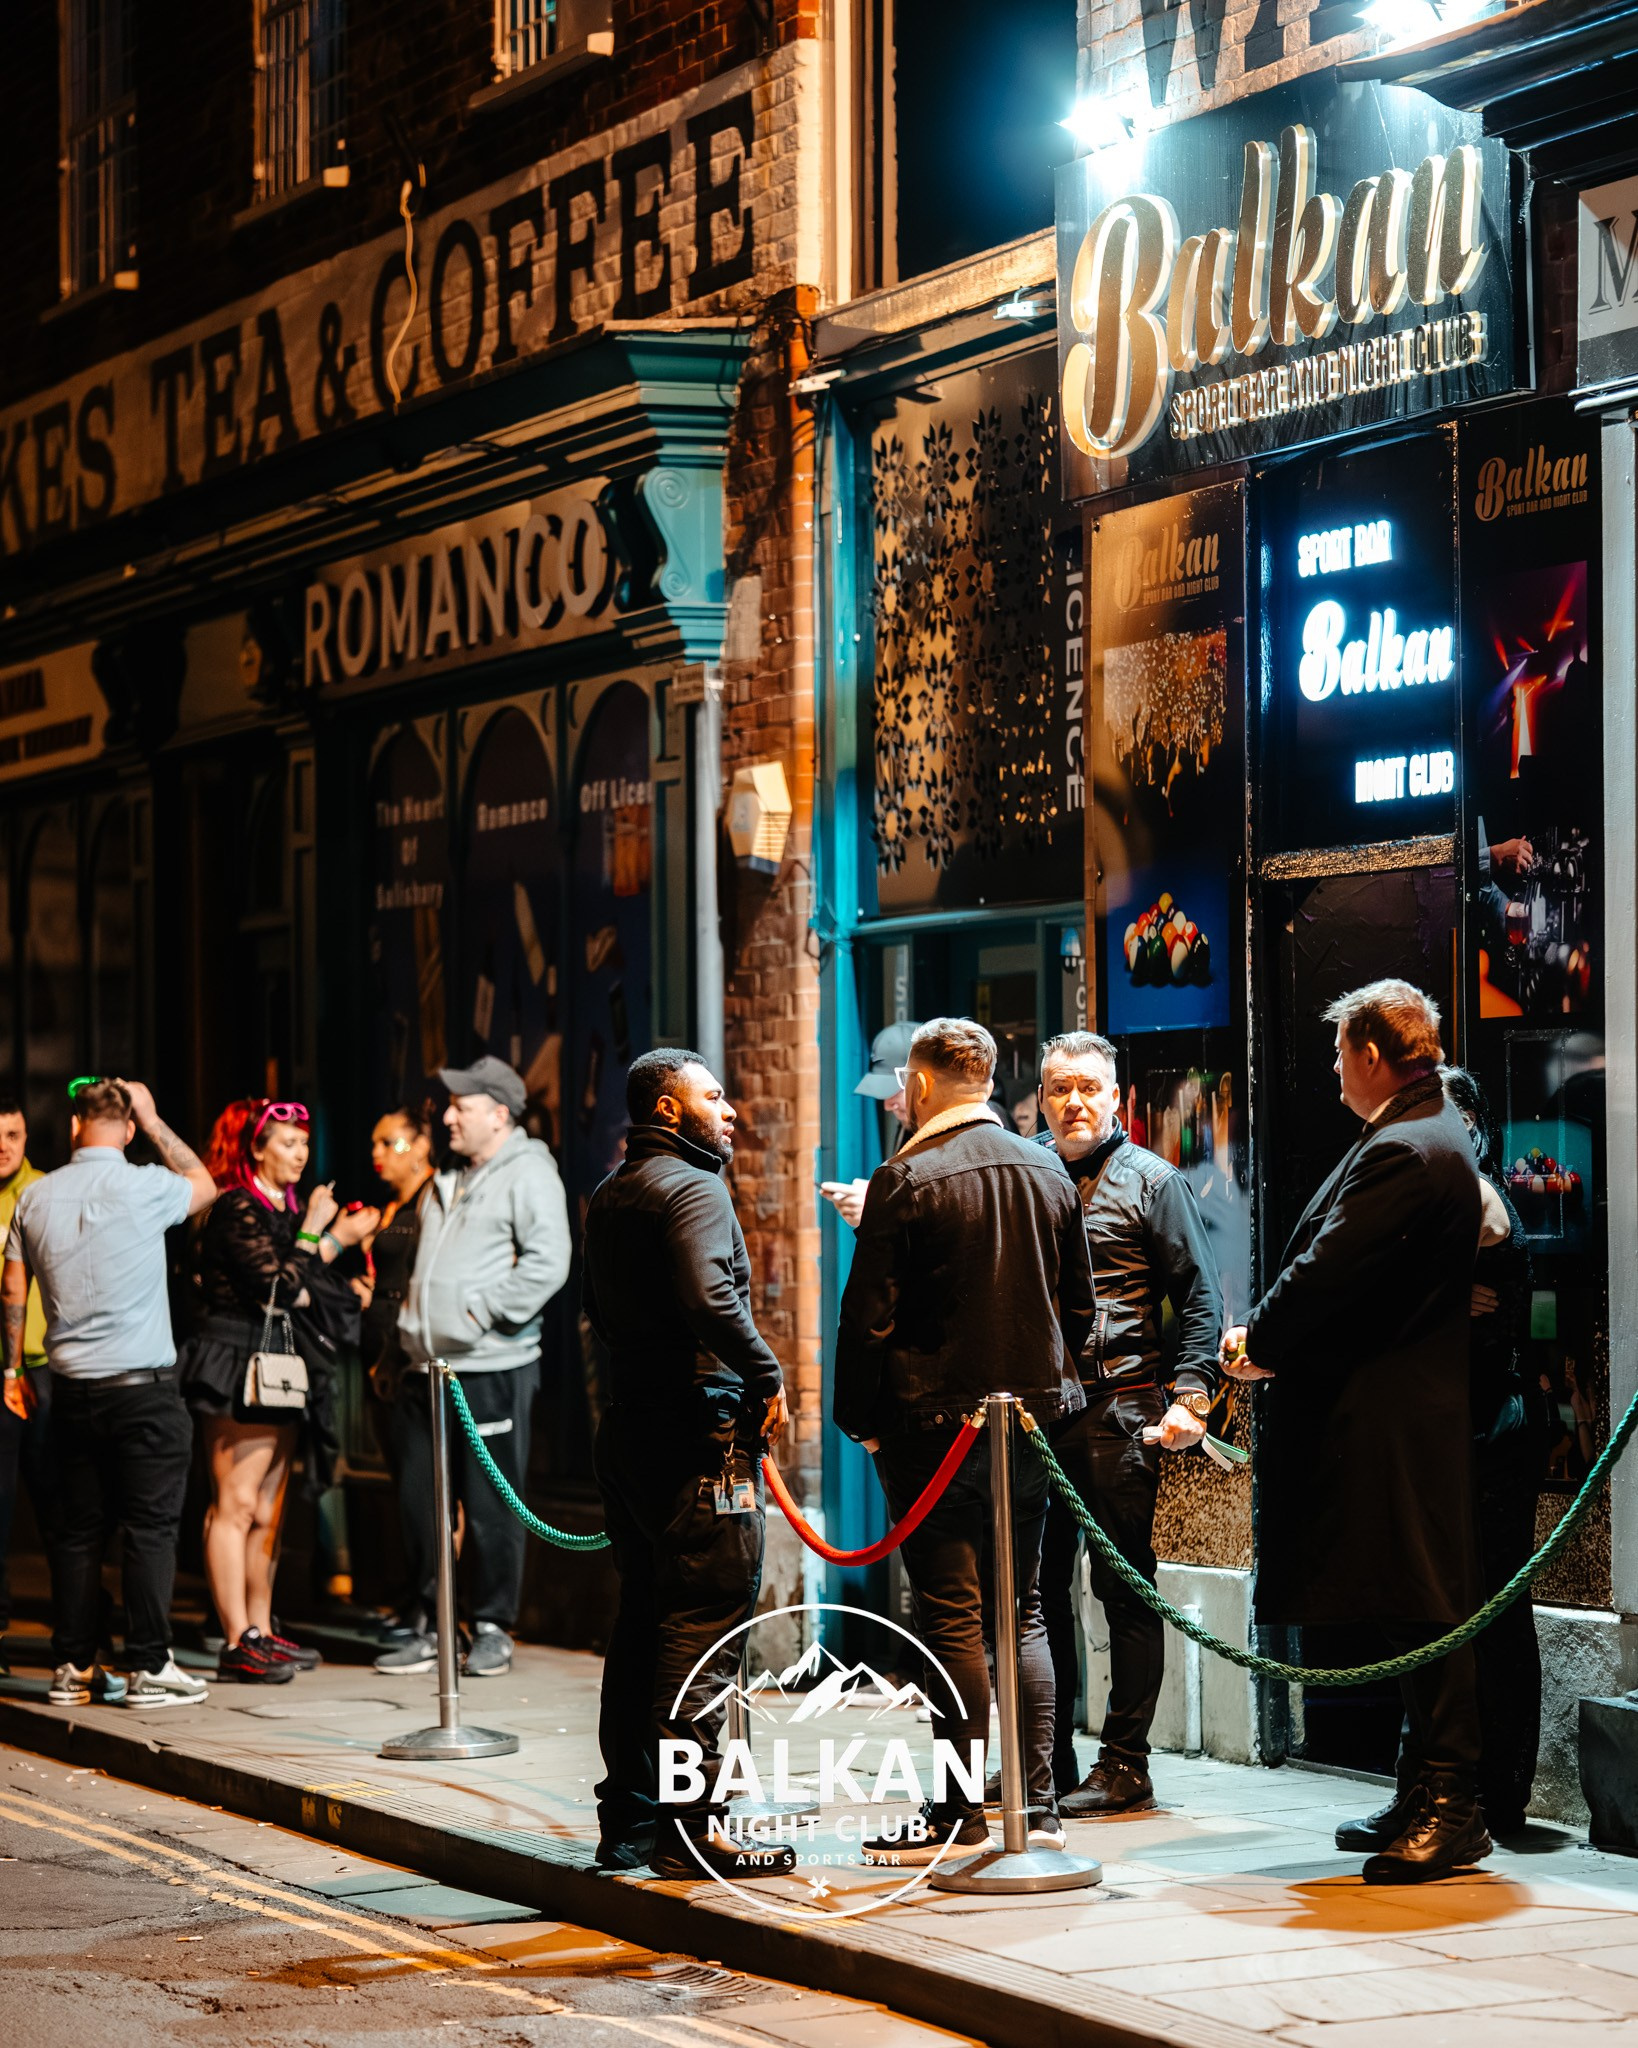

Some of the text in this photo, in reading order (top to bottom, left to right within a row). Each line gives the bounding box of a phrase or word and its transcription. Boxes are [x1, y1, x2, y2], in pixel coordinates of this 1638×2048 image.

[150, 307, 301, 495] TEA
[316, 300, 356, 430] &
[370, 91, 754, 410] COFFEE
[1063, 124, 1489, 460] Balkan
[1169, 310, 1488, 440] SPORT BAR AND NIGHT CLUB
[1475, 444, 1588, 521] Balkan
[1553, 493, 1571, 508] NIGHT
[1572, 490, 1588, 504] CLUB
[305, 500, 606, 687] ROMANCO
[1114, 522, 1220, 612] Balkan
[1187, 578, 1203, 596] NIGHT
[1204, 575, 1220, 592] CLUB
[1298, 519, 1393, 578] SPORT BAR
[1066, 548, 1086, 812] ICENCE
[1299, 600, 1454, 702] Balkan
[580, 780, 606, 813] Off
[1355, 751, 1454, 803] NIGHT CLUB
